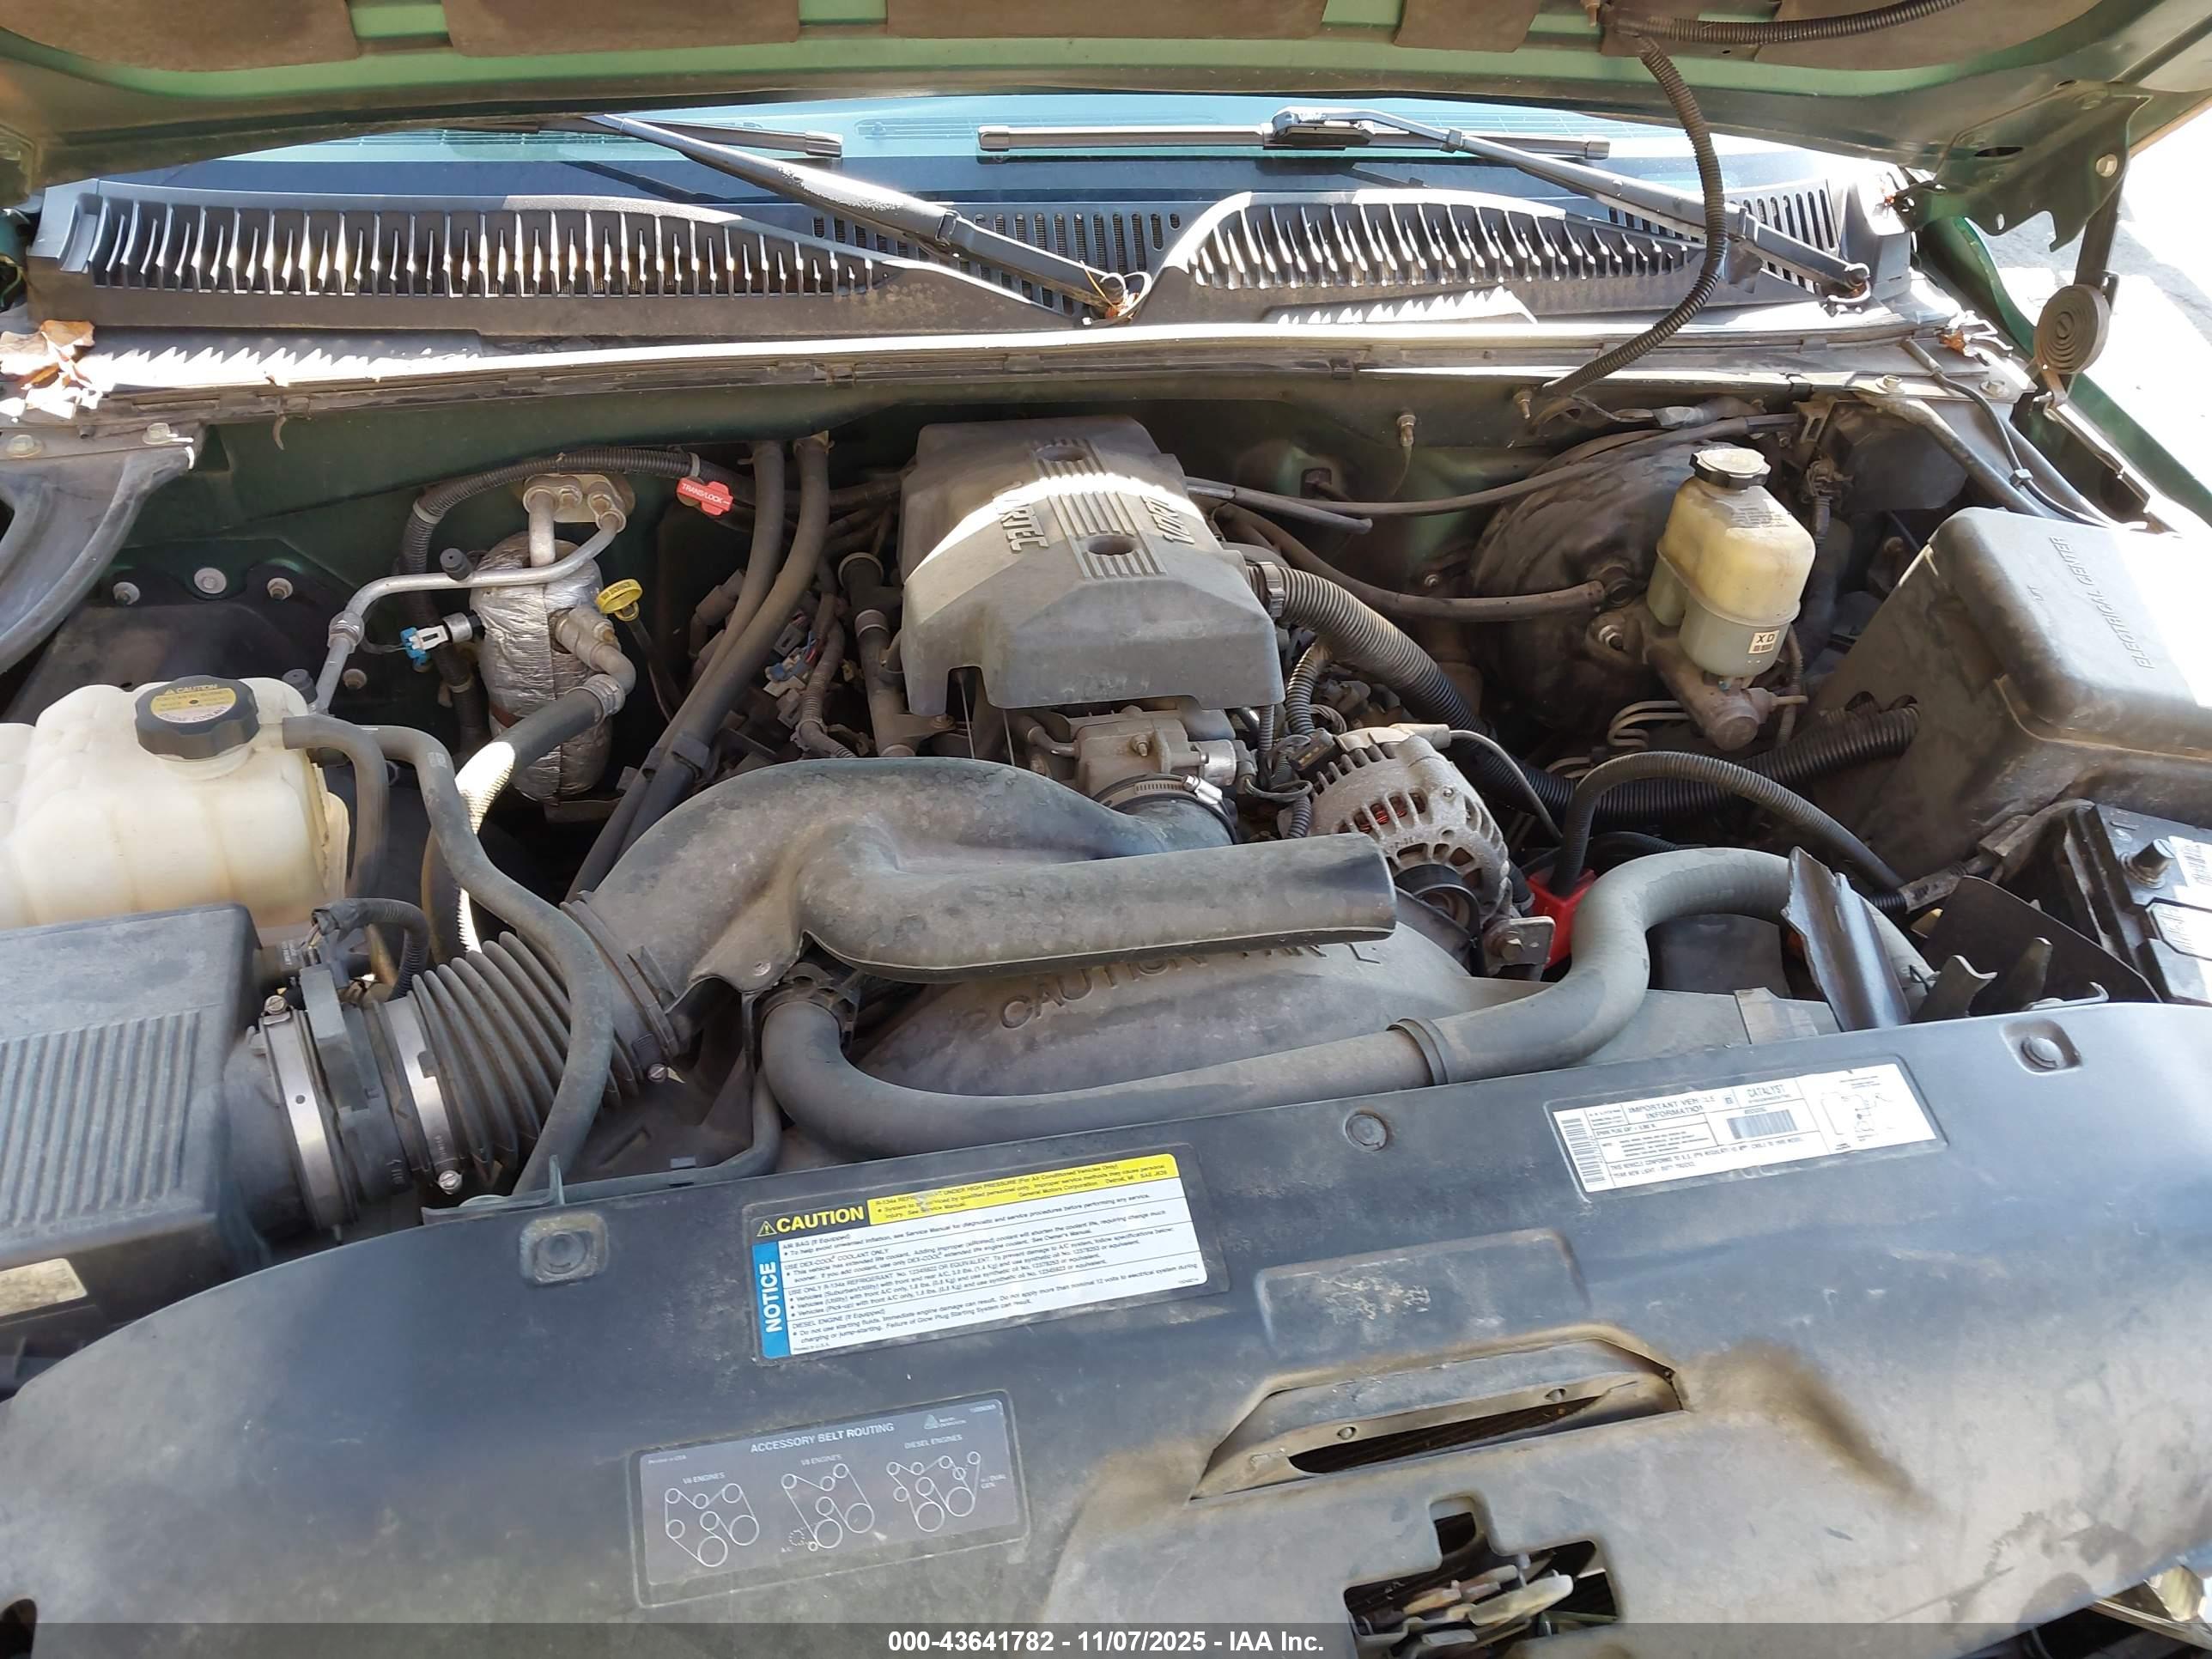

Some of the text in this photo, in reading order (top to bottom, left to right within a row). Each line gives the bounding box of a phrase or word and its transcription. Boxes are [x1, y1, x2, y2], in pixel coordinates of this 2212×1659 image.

[2048, 535, 2156, 670] ELECTRICAL CENTER
[1627, 1101, 1678, 1113] IMPORTANT
[1645, 1105, 1704, 1119] INFORMATION
[776, 1206, 865, 1233] CAUTION
[759, 1261, 782, 1333] NOTICE
[750, 1423, 895, 1452] ACCESSORY BELT ROUTING
[930, 1434, 963, 1445] ENGINES
[811, 1454, 842, 1464] ENGINES
[692, 1472, 726, 1483] ENGINES
